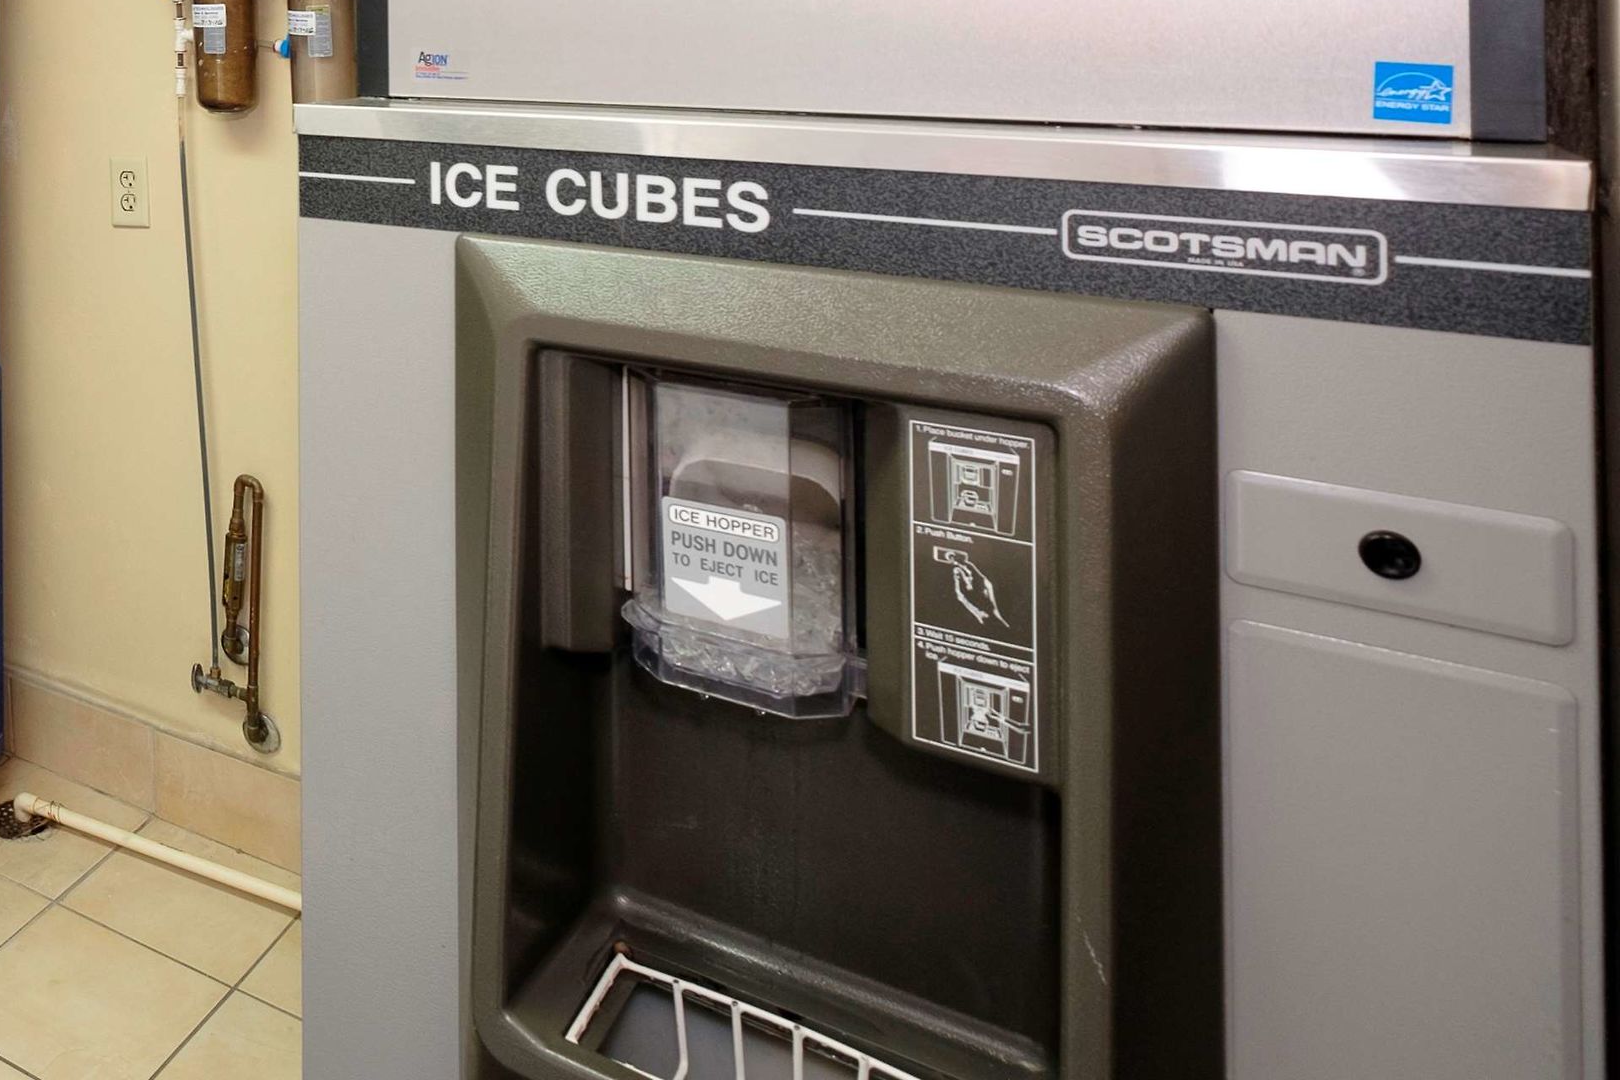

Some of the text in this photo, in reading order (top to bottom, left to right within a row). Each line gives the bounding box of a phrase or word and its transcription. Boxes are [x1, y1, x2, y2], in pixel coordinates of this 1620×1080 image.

[430, 161, 771, 233] ICE CUBES
[1077, 225, 1367, 267] SCOTSMAN
[1187, 257, 1212, 265] MADE
[947, 429, 973, 441] bucket
[974, 433, 997, 444] under
[674, 508, 775, 540] ICE HOPPER
[671, 530, 778, 567] PUSH DOWN
[672, 552, 779, 586] TO EJECT ICE
[925, 629, 943, 641] Wait
[925, 643, 947, 655] Push
[947, 648, 976, 662] hopper
[976, 655, 998, 667] down
